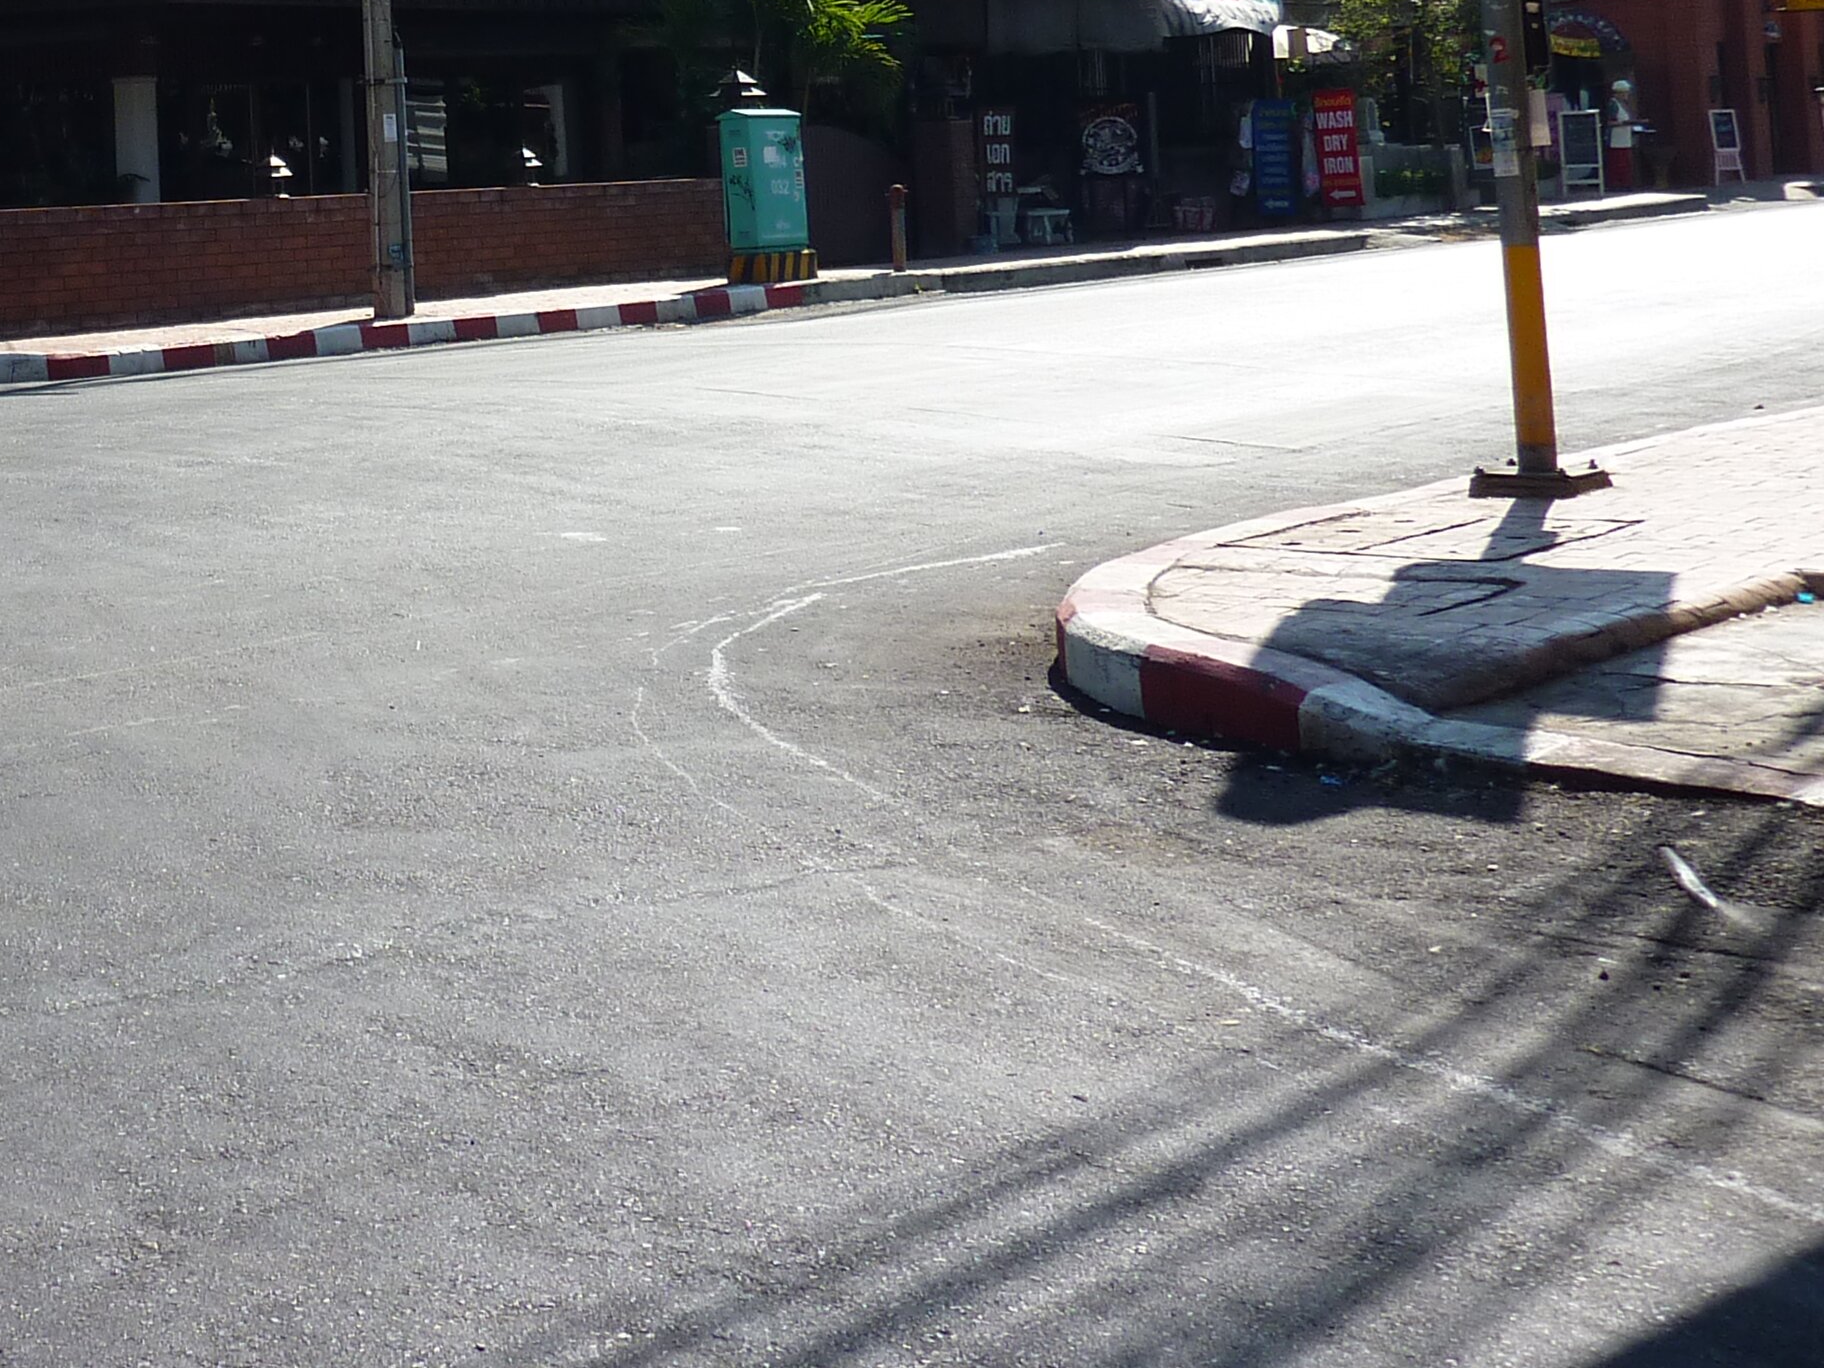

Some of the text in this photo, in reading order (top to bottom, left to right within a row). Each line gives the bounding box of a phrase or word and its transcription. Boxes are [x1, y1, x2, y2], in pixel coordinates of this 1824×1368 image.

[983, 110, 1012, 136] ถ่าย
[1316, 110, 1354, 129] WASH
[986, 142, 1011, 164] เอก
[1322, 134, 1349, 152] DRY
[1323, 156, 1354, 174] IRON
[986, 169, 1014, 192] สาร
